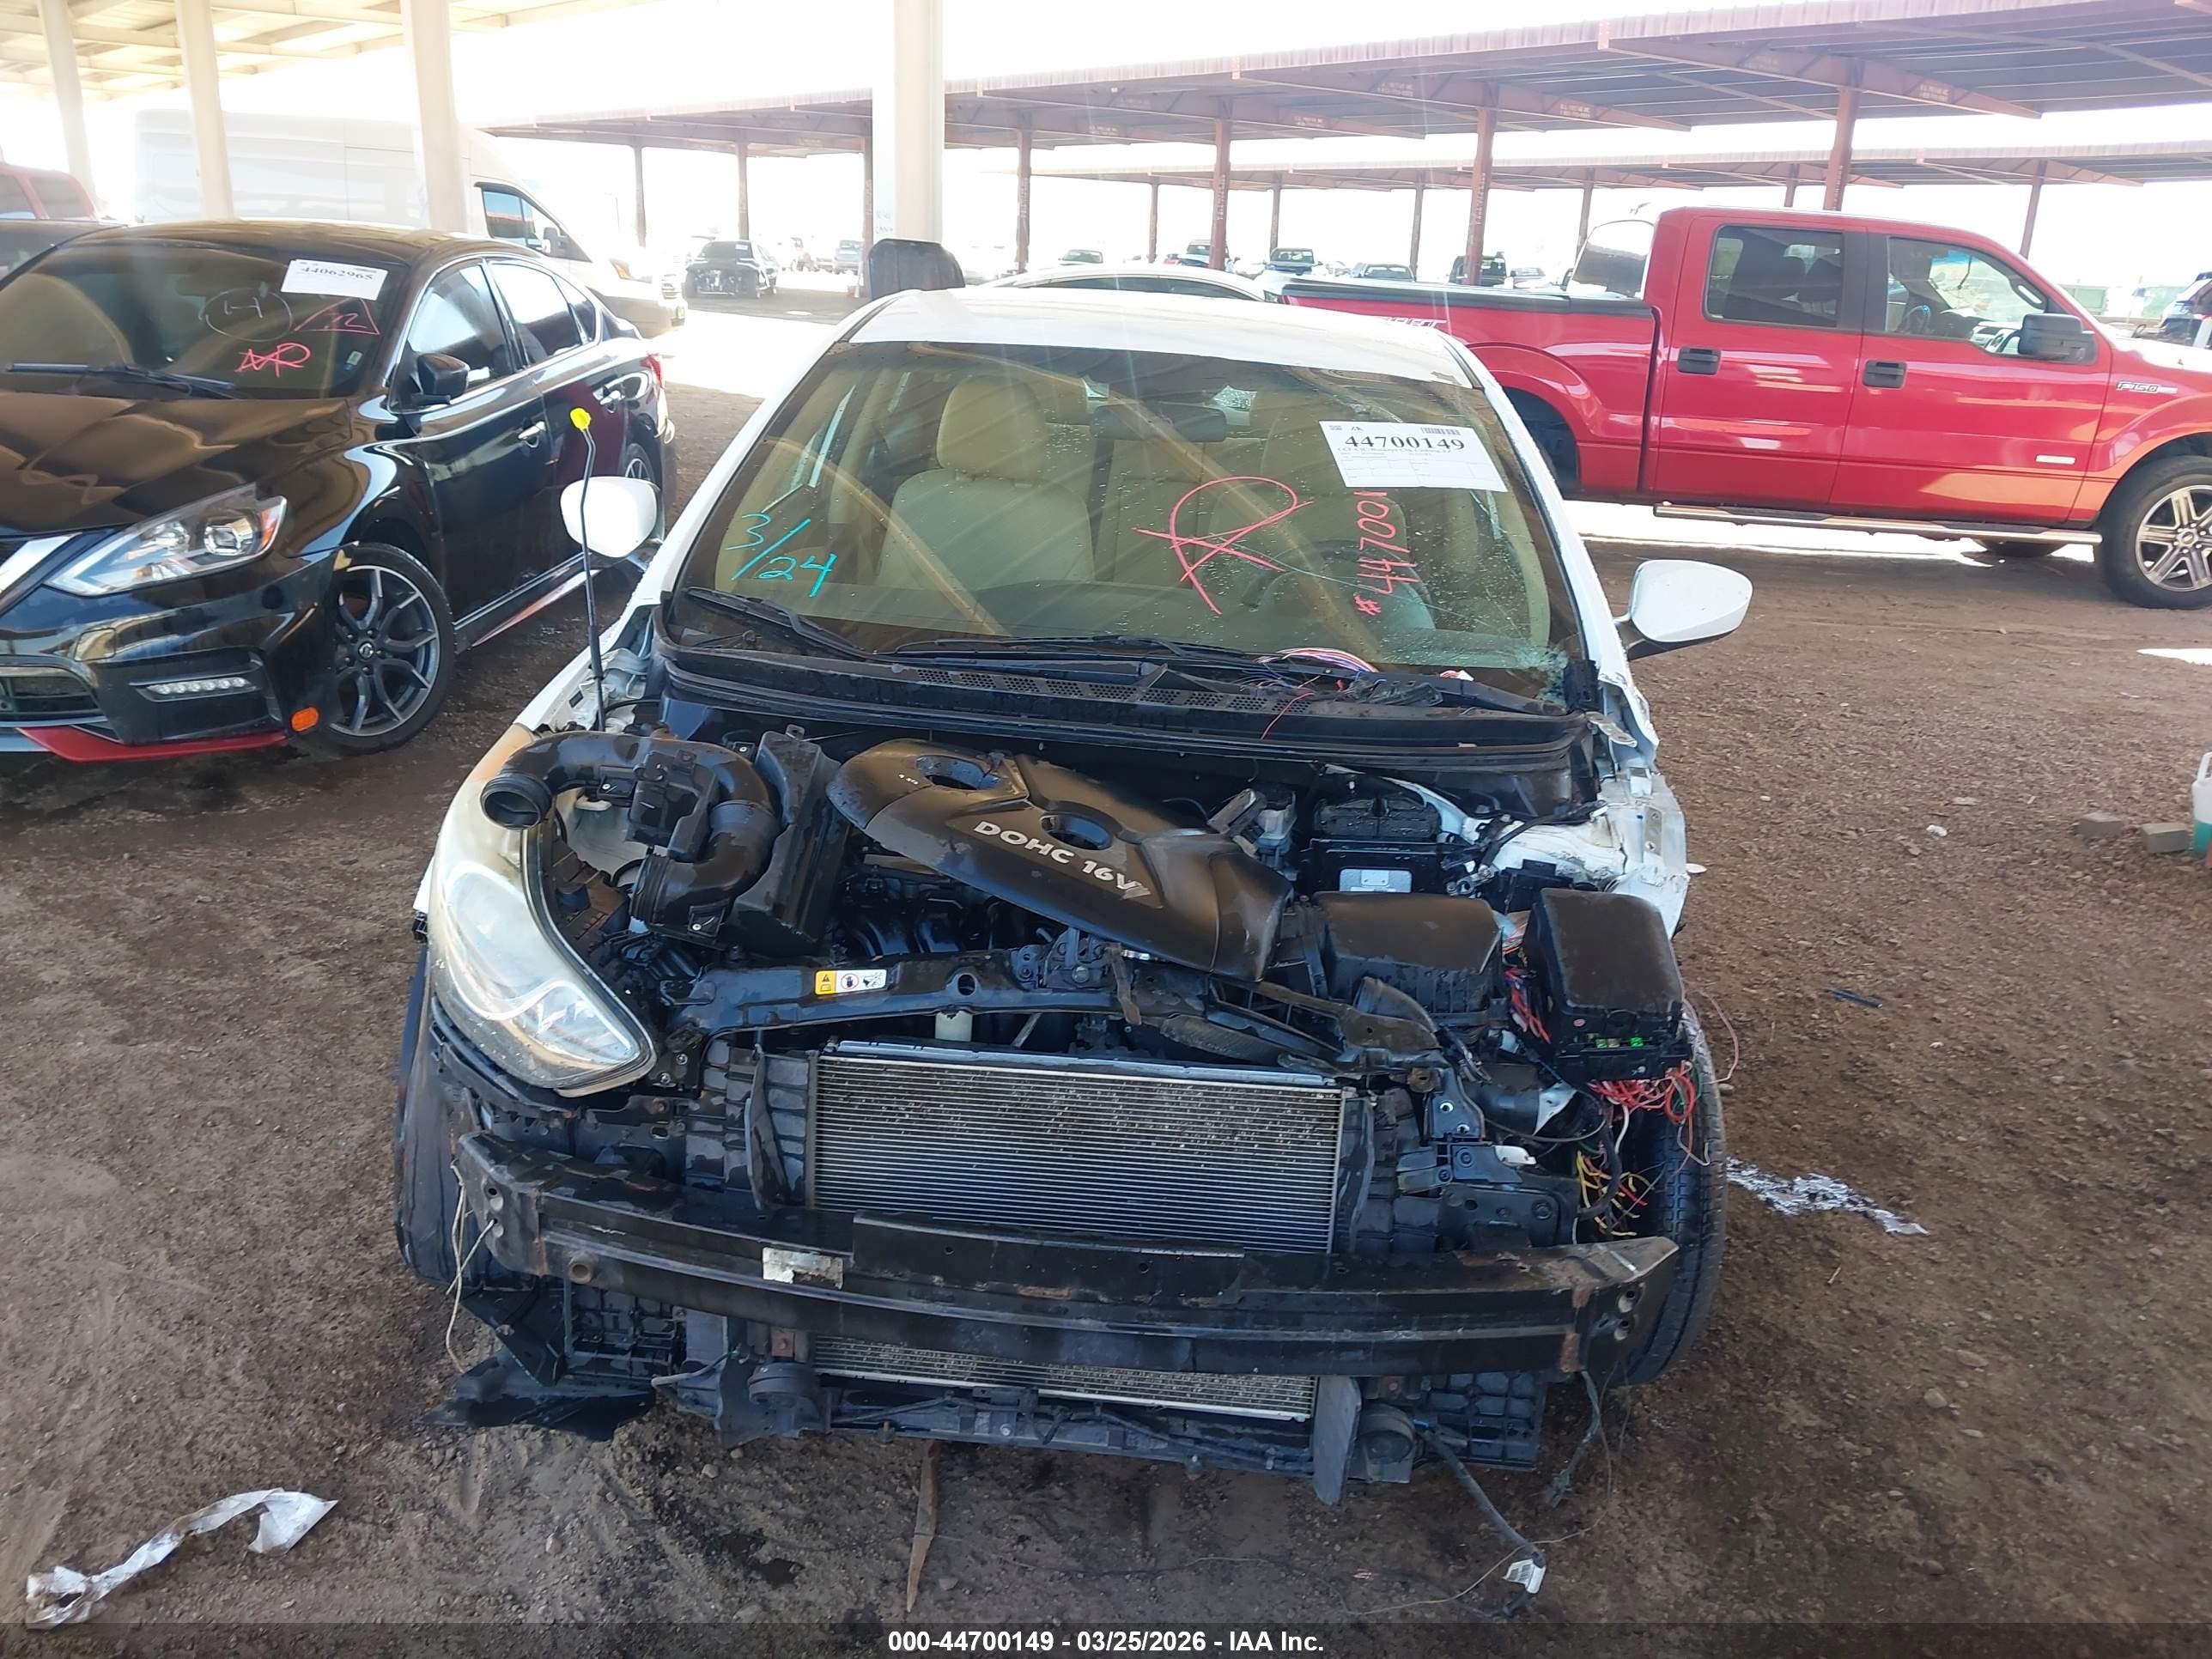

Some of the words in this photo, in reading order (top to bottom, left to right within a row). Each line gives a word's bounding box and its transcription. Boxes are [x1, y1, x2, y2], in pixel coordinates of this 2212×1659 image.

[1344, 435, 1465, 451] 44700149
[726, 513, 838, 598] 3/24
[972, 820, 1075, 865] DOHC
[1081, 860, 1148, 895] 16V
